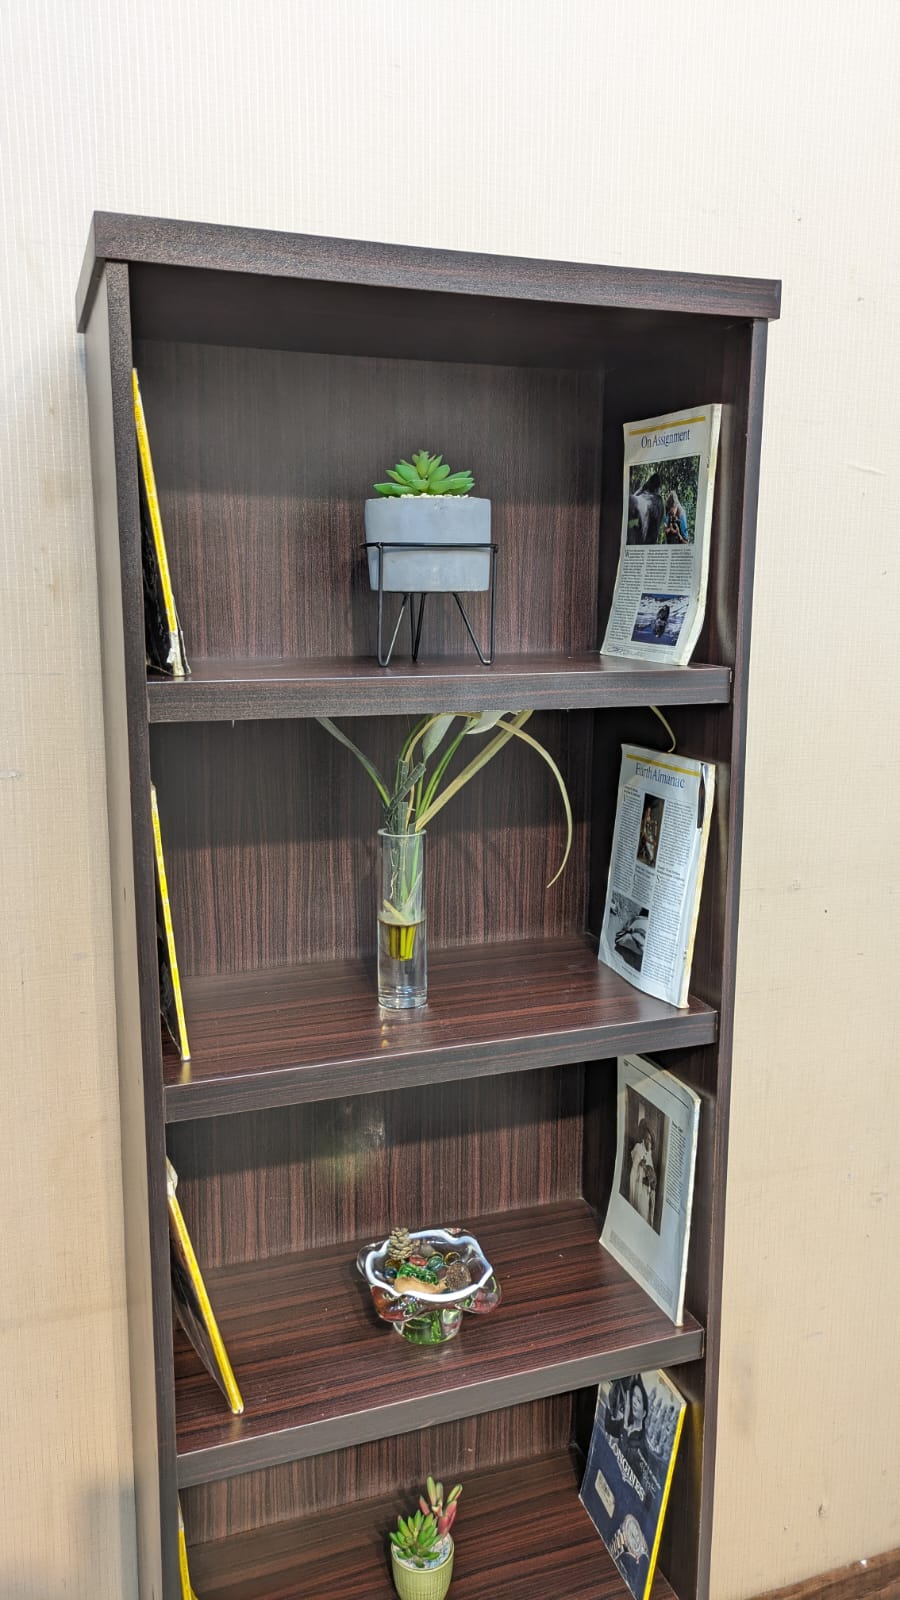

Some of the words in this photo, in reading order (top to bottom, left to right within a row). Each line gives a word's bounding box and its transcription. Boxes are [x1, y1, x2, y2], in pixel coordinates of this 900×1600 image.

[641, 434, 652, 449] On
[652, 429, 690, 447] Assignment
[635, 761, 653, 780] Earth
[653, 768, 686, 789] Almanac
[608, 1435, 646, 1501] LONGINES
